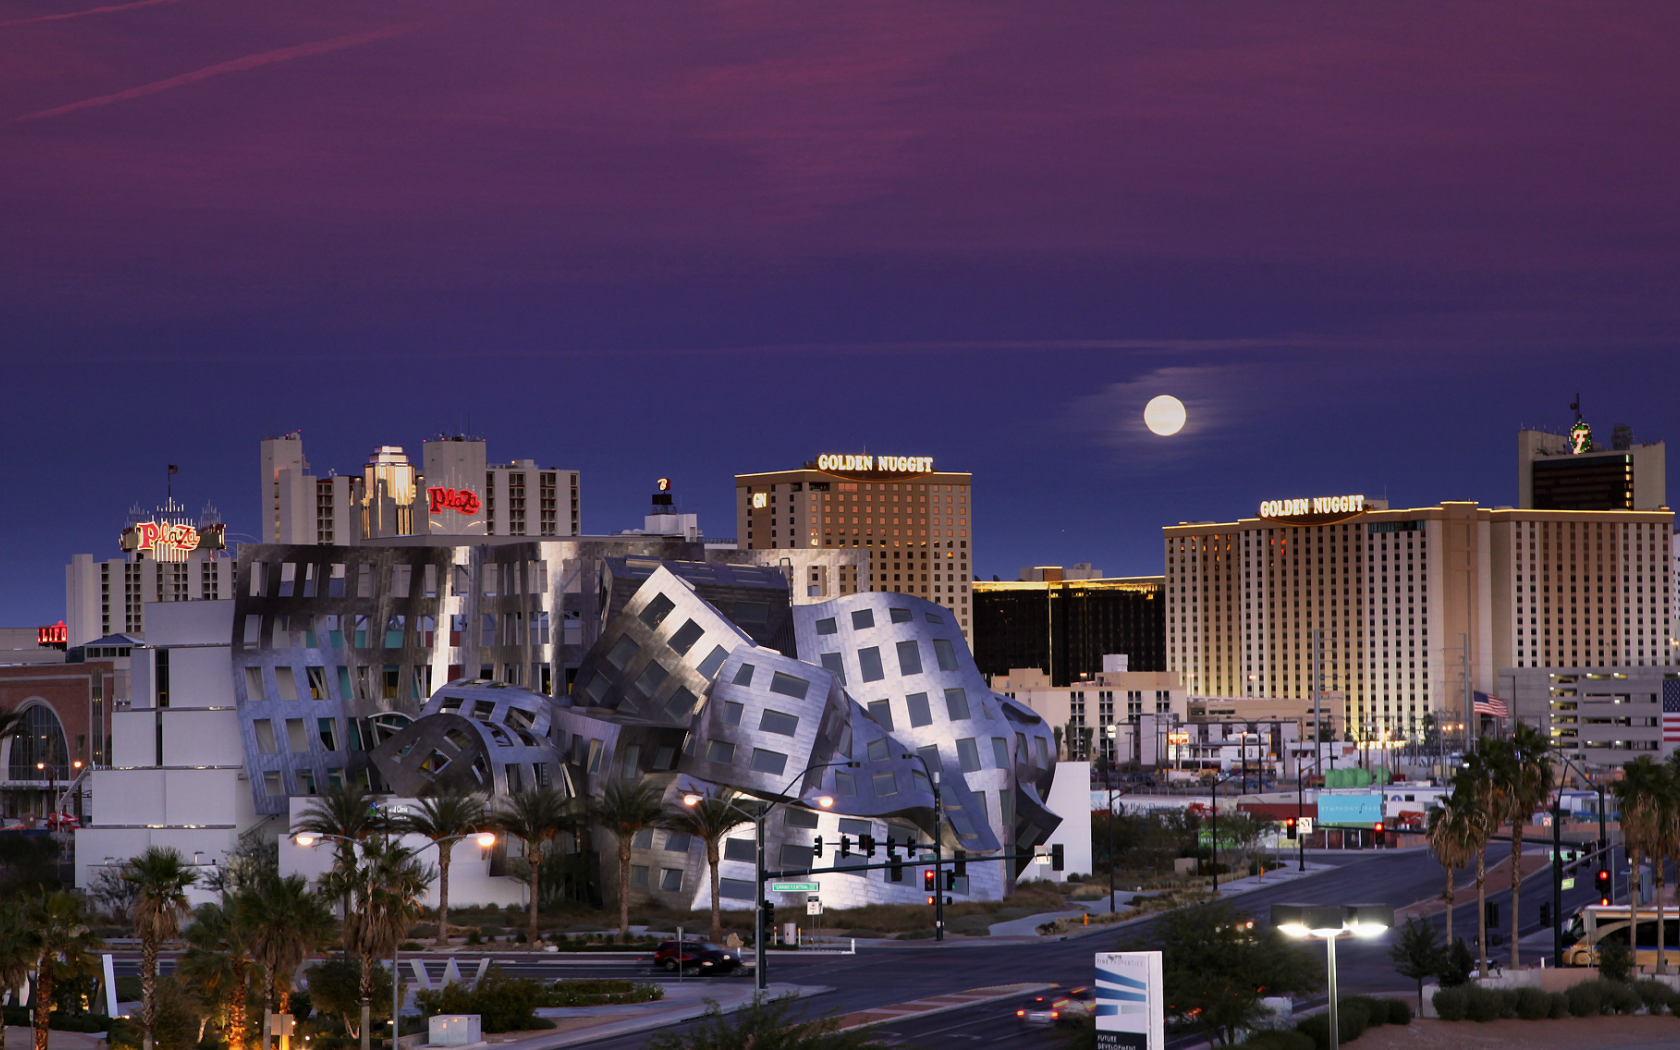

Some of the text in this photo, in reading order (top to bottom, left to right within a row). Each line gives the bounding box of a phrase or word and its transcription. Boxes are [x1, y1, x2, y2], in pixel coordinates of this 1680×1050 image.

[818, 455, 933, 472] GOLDEN NUGGET
[427, 486, 482, 515] Plaza
[752, 492, 767, 508] GN
[1260, 494, 1365, 518] GOLDEN NUGGET
[136, 520, 200, 551] Plaza
[1097, 1034, 1117, 1043] FUTURE
[1097, 1042, 1137, 1050] DEVELOPMENT
